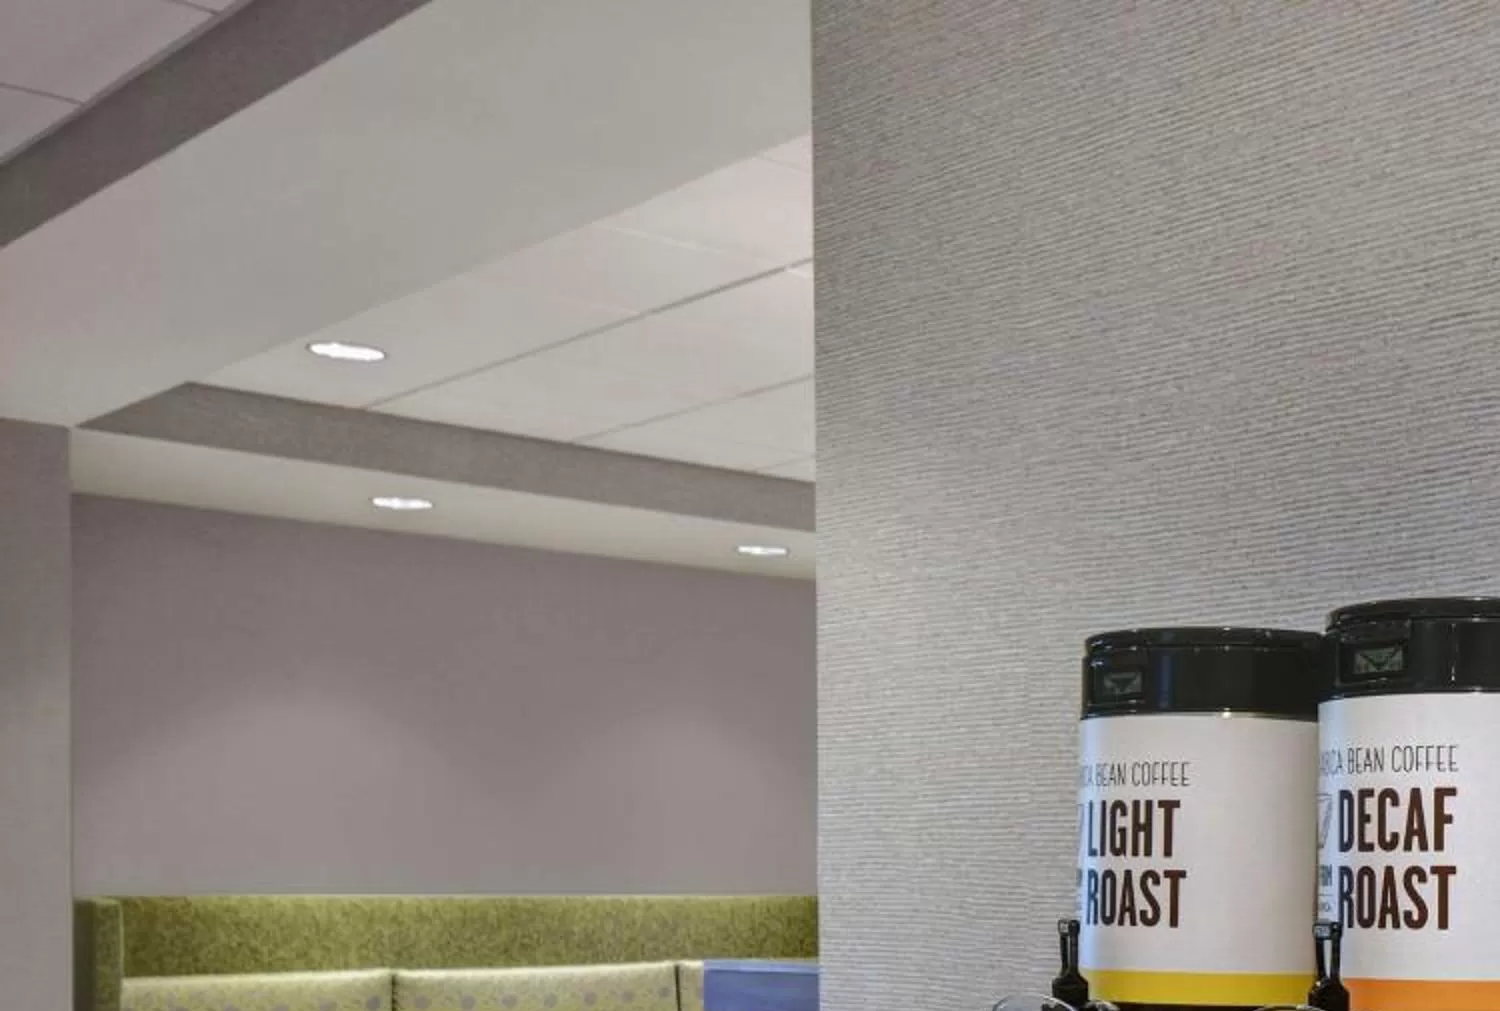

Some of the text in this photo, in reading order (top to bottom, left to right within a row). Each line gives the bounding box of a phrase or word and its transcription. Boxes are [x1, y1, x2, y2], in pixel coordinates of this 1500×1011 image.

[1095, 762, 1127, 787] BEAN
[1131, 761, 1191, 787] COFFEE
[1347, 746, 1384, 775] BEAN
[1391, 744, 1459, 773] COFFEE
[1087, 798, 1182, 858] LIGHT
[1338, 786, 1457, 853] DECAF
[1086, 868, 1187, 929] ROAST
[1338, 865, 1457, 930] ROAST
